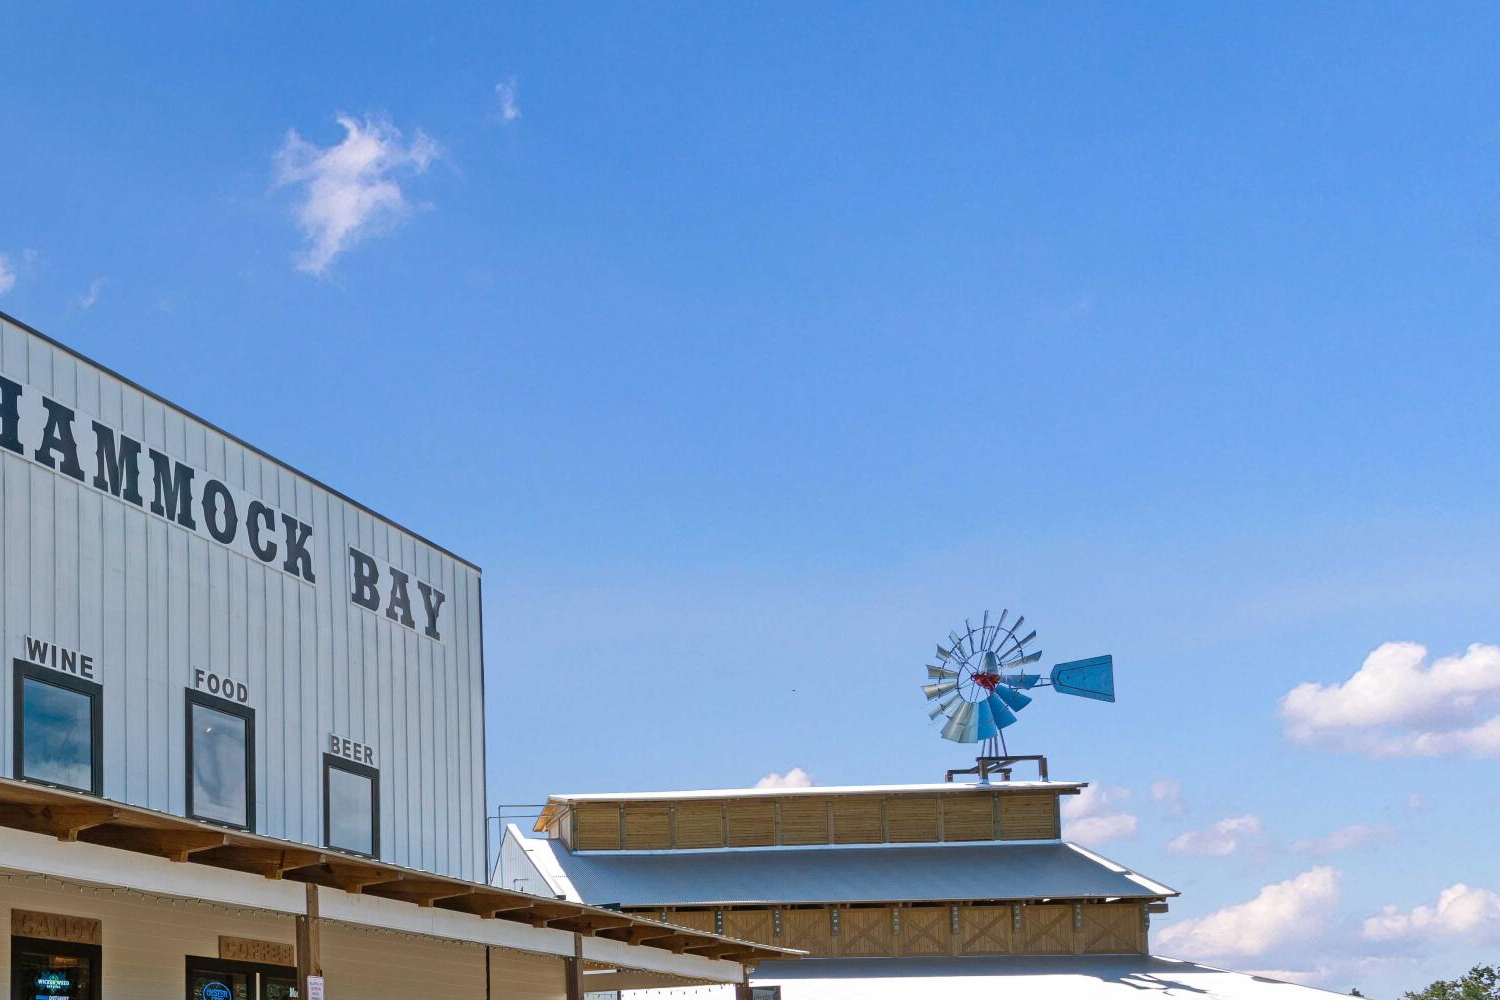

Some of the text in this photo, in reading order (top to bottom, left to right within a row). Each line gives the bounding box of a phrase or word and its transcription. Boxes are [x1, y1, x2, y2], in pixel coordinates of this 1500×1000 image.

[349, 546, 445, 641] BAY
[26, 636, 94, 679] WINE
[195, 668, 248, 703] FOOD
[330, 735, 373, 765] BEER
